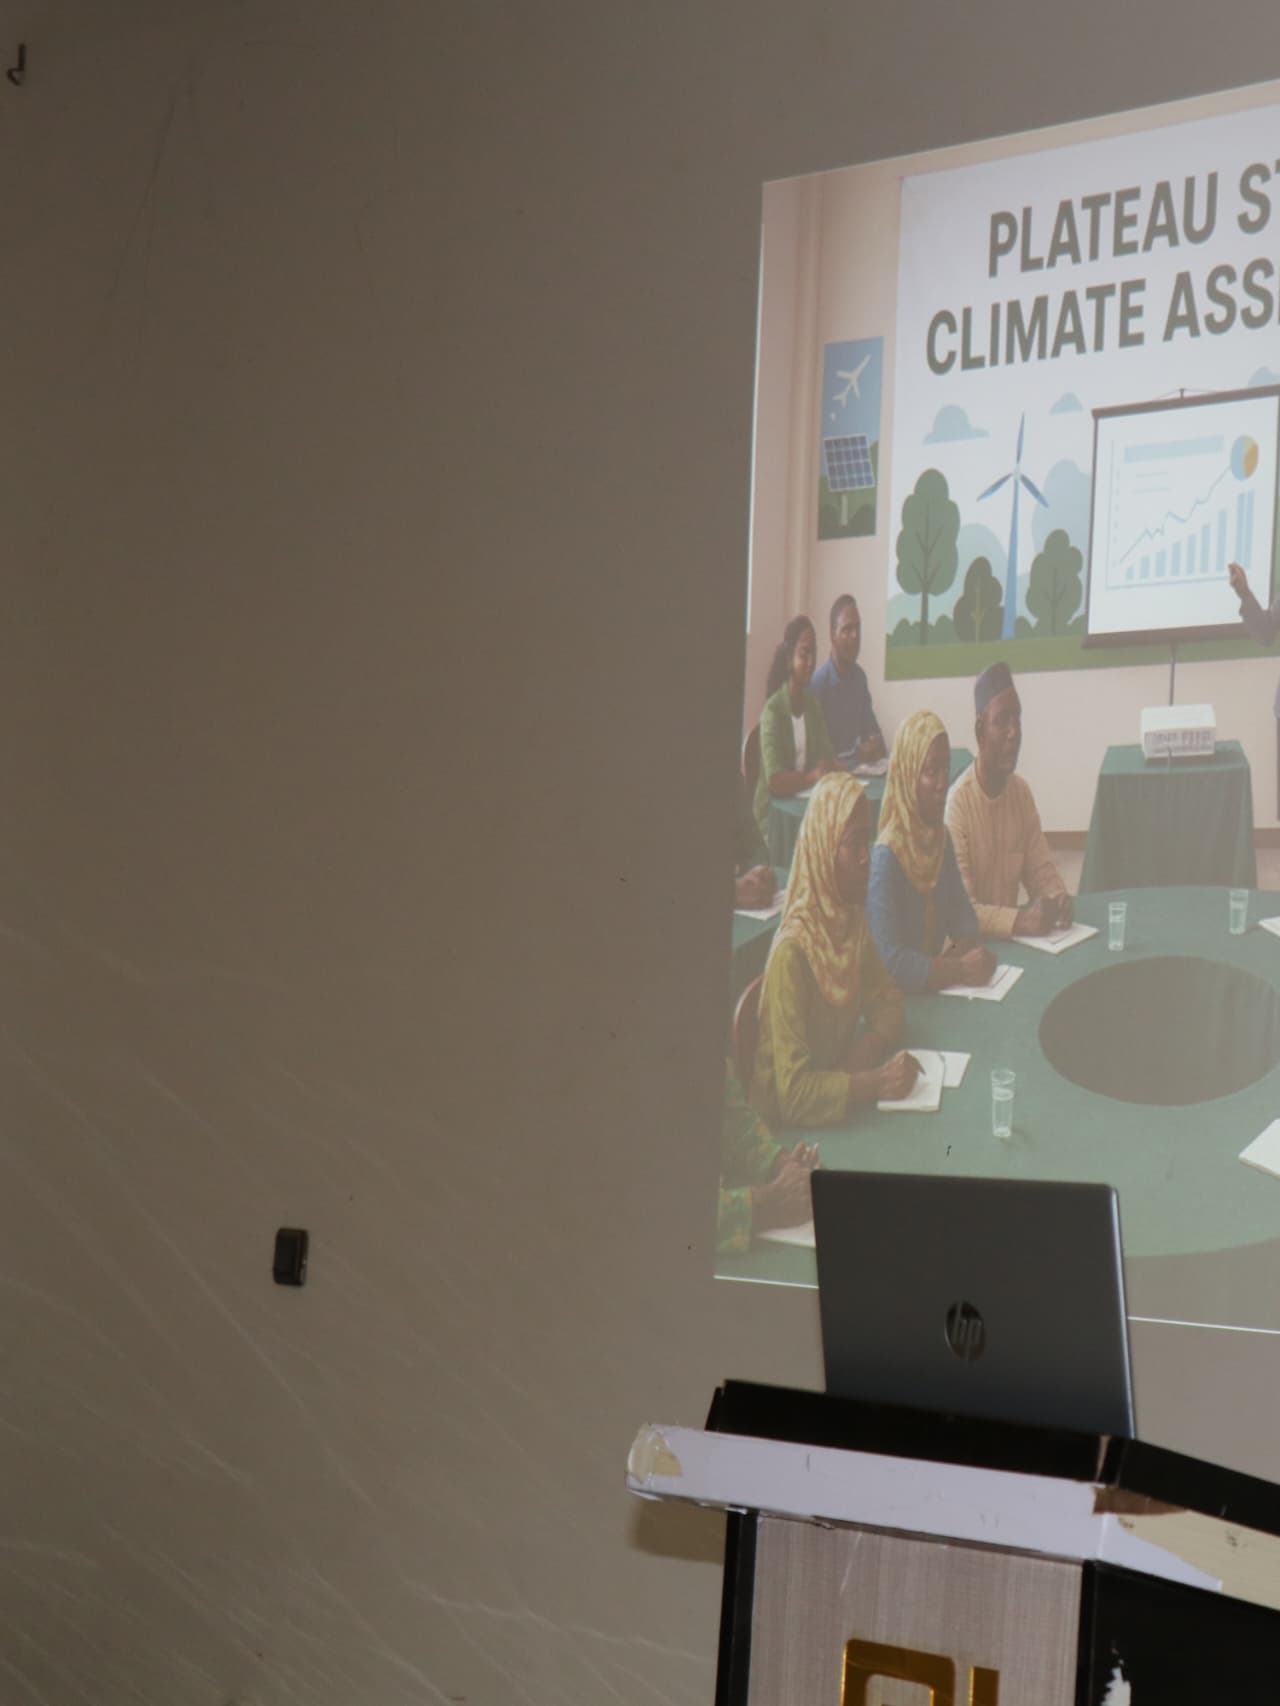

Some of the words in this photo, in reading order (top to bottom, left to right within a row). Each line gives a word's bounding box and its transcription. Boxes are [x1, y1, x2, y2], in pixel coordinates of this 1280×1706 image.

[988, 171, 1219, 278] PLATEAU
[926, 278, 1146, 375] CLIMATE
[949, 1301, 986, 1362] hp
